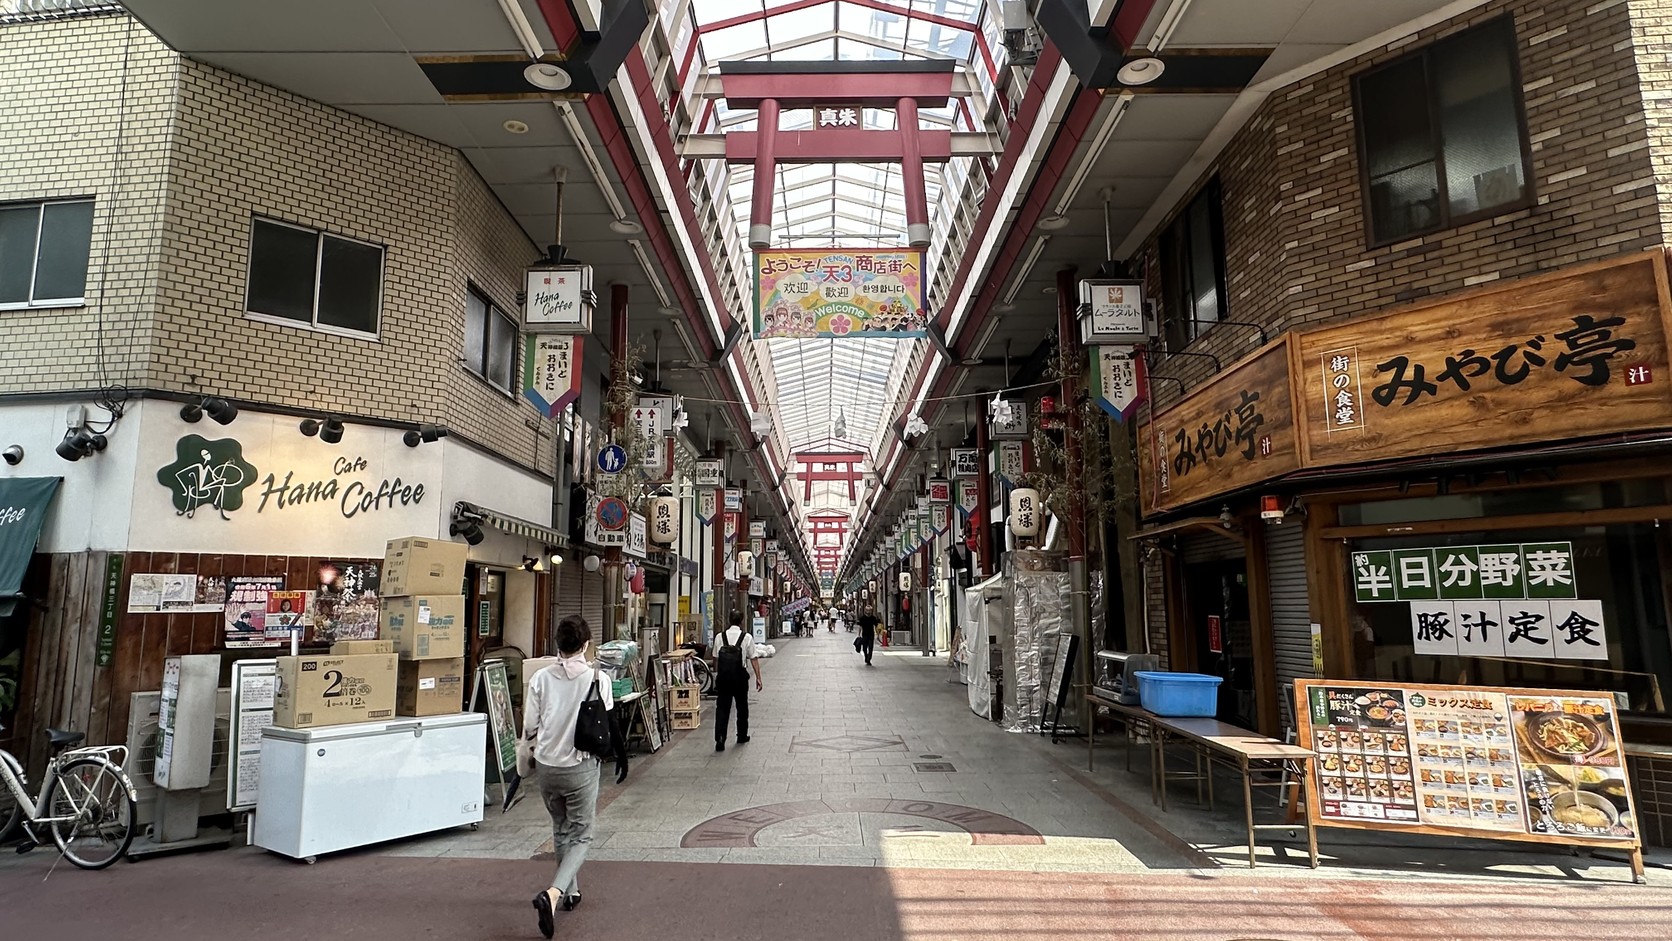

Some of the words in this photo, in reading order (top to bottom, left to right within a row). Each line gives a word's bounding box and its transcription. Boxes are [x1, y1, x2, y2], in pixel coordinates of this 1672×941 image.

[761, 257, 821, 274] ようこそ!
[822, 264, 852, 283] 天3
[856, 255, 917, 274] 商店街へ
[534, 291, 560, 306] Hana
[783, 282, 809, 294] 欢迎
[825, 287, 849, 298] 歡迎
[862, 284, 905, 294] 환영합니다
[542, 300, 573, 317] Coffee
[814, 302, 865, 319] Welcome
[1094, 308, 1140, 317] ムーラタルト
[558, 351, 568, 379] まいど
[1371, 314, 1637, 407] みやび亭
[545, 354, 556, 391] おおきに
[1112, 364, 1123, 399] おおきに
[1122, 361, 1132, 387] まいど
[1628, 365, 1650, 384] 汁
[1330, 355, 1355, 425] 街の食堂
[1174, 389, 1264, 477] みやび亭
[1261, 437, 1271, 455] 汁
[333, 456, 368, 476] Cafe
[257, 470, 340, 514] Hana
[341, 477, 426, 519] Coffee
[598, 534, 624, 542] 自動車
[1355, 553, 1369, 566] 約
[342, 566, 357, 602] 天神祭
[1357, 550, 1573, 597] 半日分野菜
[106, 572, 117, 619] 天神橋三丁目
[104, 624, 111, 634] 2
[1416, 611, 1601, 646] 豚汁定食
[322, 670, 343, 698] 2
[1330, 700, 1352, 710] 豚汁
[1427, 697, 1493, 710] ミックス定食
